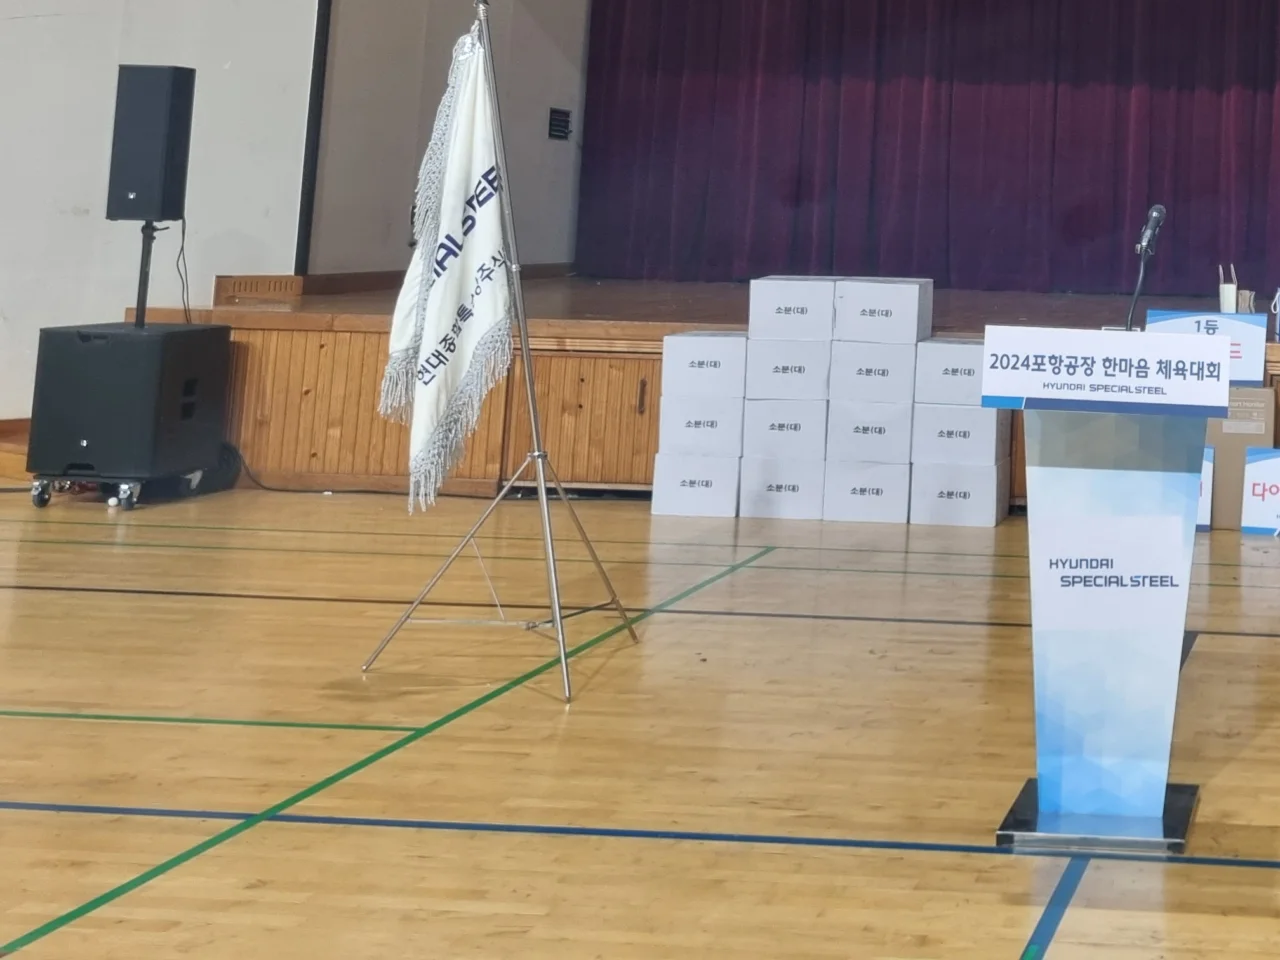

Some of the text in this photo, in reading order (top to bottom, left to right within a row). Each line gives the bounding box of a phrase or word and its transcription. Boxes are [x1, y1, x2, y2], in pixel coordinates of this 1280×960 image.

[775, 305, 808, 315] 소분(대)
[859, 308, 893, 318] 소분(대)
[1194, 319, 1219, 336] 1등
[688, 359, 721, 370] 소분(대)
[772, 365, 806, 375] 소분(대)
[989, 352, 1222, 382] 2024포항공장 한마음 체육대회
[856, 367, 889, 377] 소분(대)
[941, 367, 976, 377] 소분(대)
[1042, 381, 1086, 392] HYUNDAI
[684, 419, 718, 430] 소분(대)
[768, 422, 802, 432] 소분(대)
[852, 424, 886, 435] 소분(대)
[937, 428, 971, 439] 소분(대)
[679, 478, 713, 489] 소분(대)
[765, 483, 800, 494] 소분(대)
[849, 486, 884, 497] 소분(대)
[936, 489, 972, 500] 소분(대)
[1049, 557, 1114, 570] HYUNDAI
